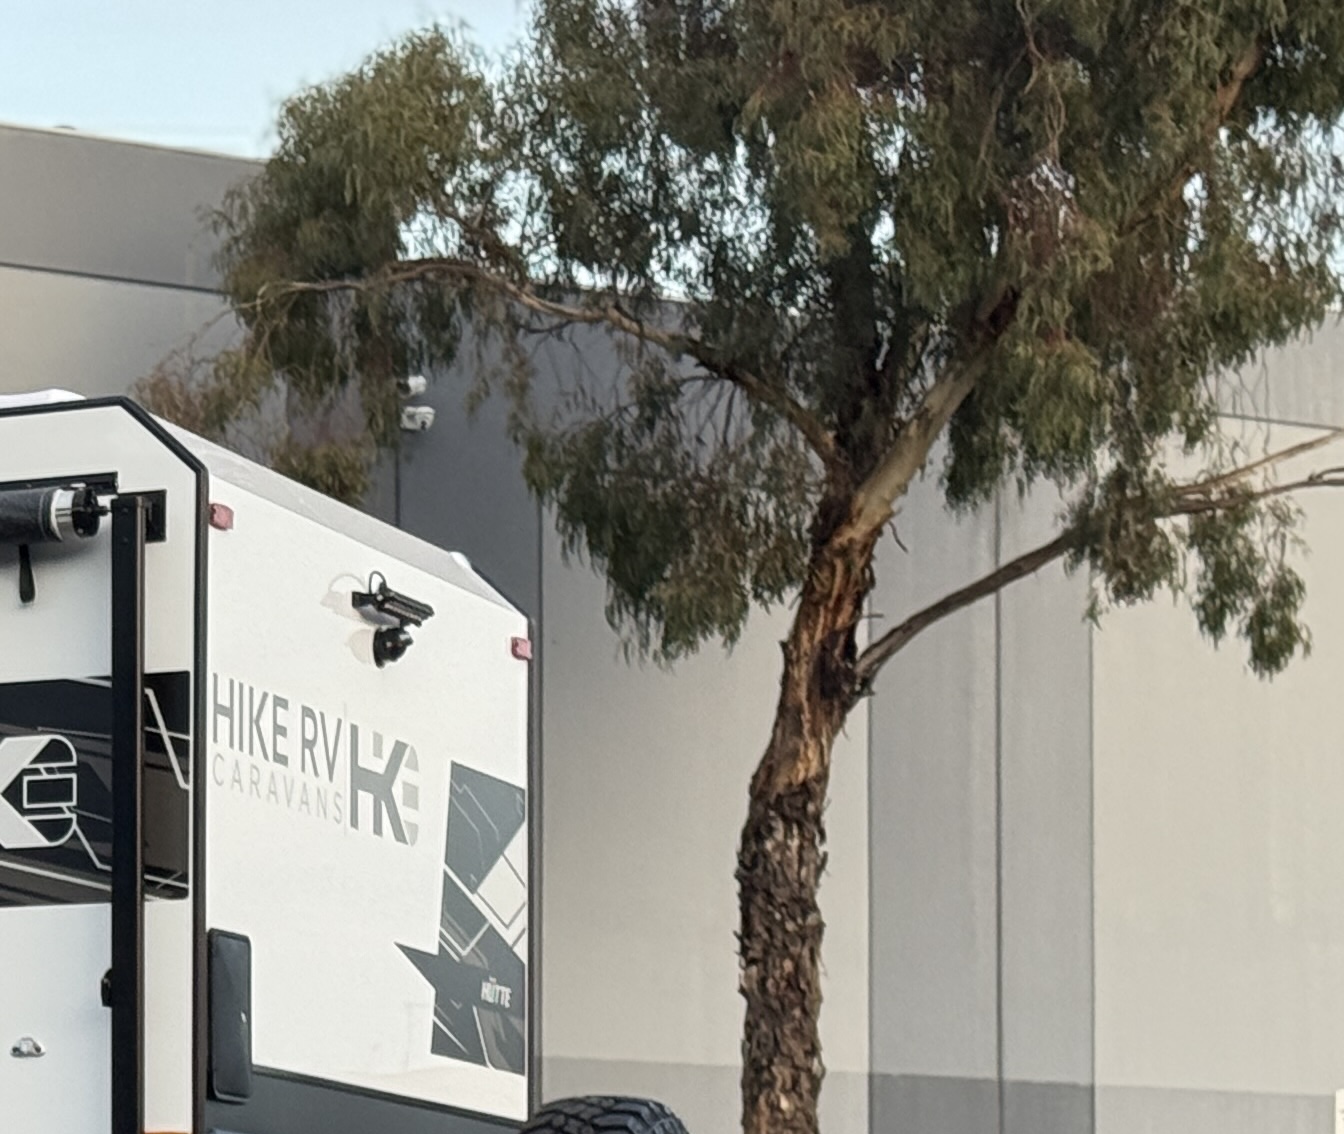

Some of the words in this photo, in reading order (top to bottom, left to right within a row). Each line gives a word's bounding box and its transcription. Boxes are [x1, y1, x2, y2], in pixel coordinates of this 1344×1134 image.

[212, 672, 289, 768] HIKE
[300, 704, 343, 784] RV
[212, 752, 344, 825] CARAVANS
